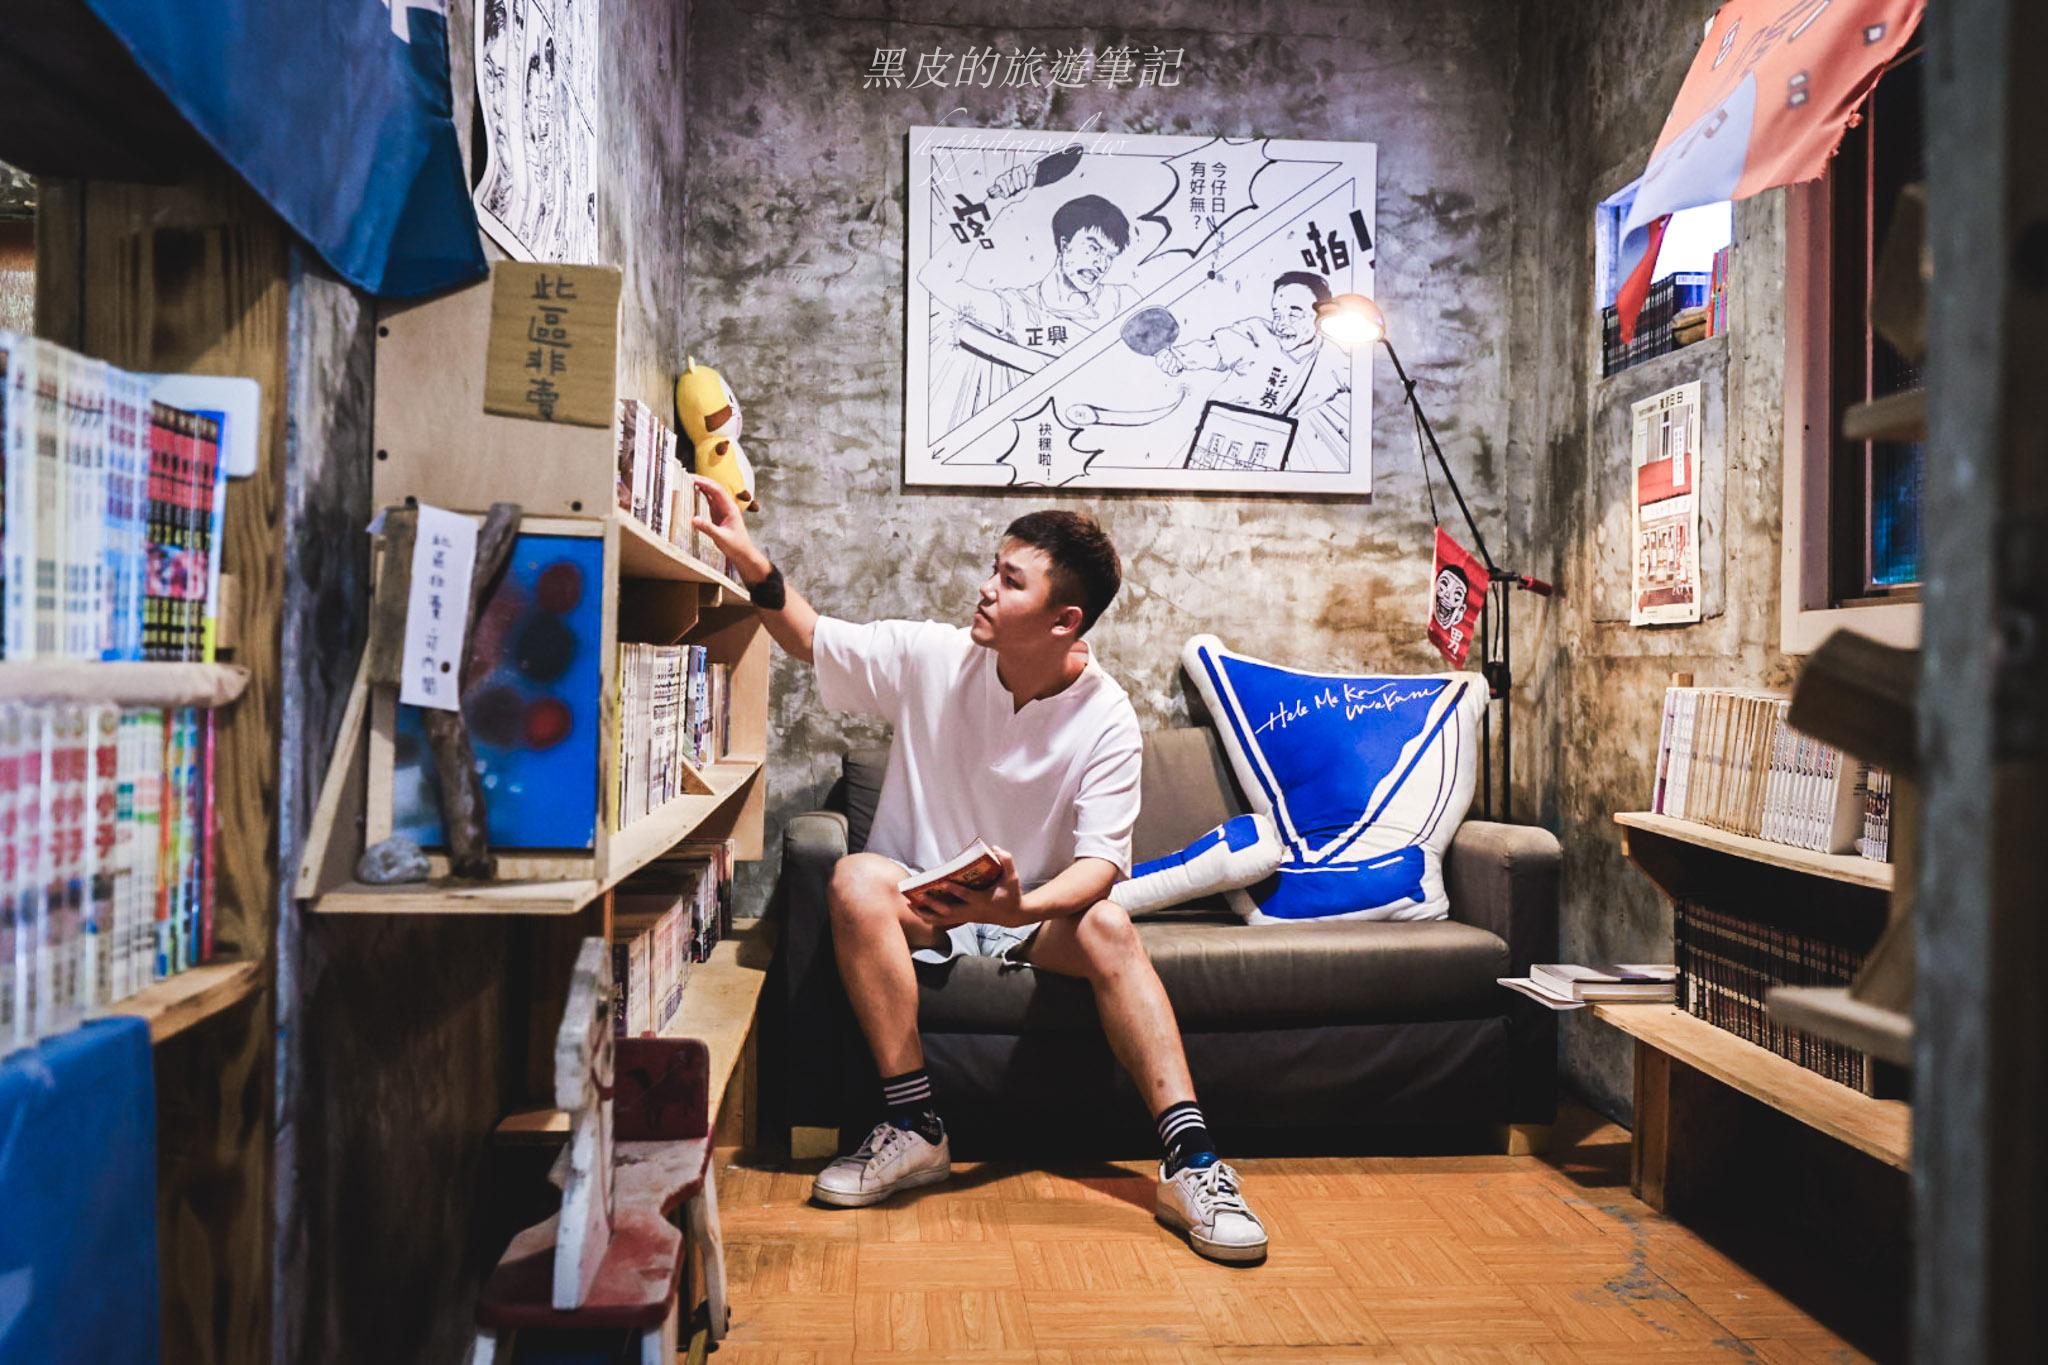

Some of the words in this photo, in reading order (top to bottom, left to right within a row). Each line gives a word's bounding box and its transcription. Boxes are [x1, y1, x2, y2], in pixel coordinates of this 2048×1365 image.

[1211, 161, 1227, 213] 今仔日
[1025, 325, 1069, 346] 正興
[1447, 627, 1464, 655] 男
